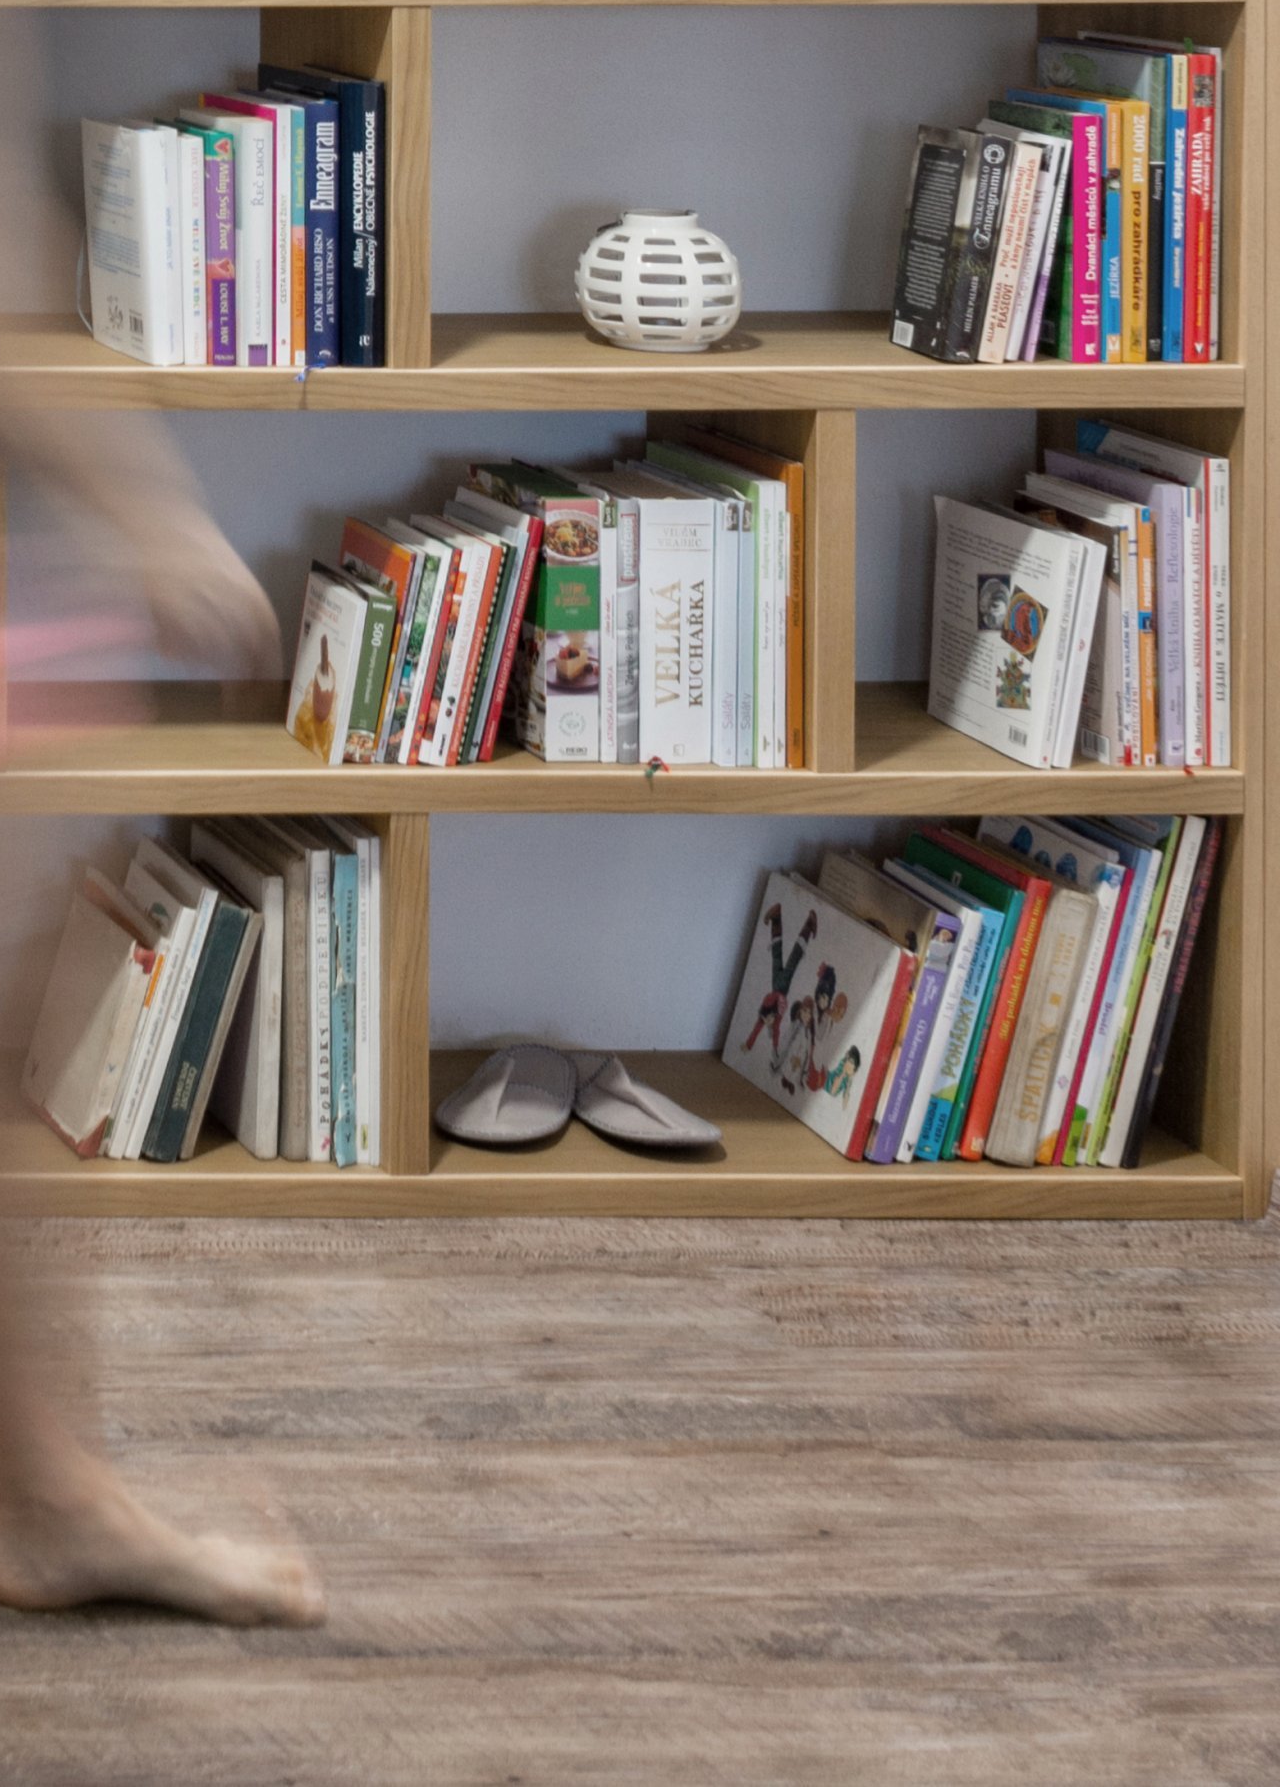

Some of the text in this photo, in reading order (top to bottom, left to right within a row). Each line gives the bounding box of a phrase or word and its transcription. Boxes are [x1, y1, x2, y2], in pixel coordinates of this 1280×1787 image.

[250, 137, 265, 206] ŘEČ EMOCÍ
[310, 121, 337, 211] Enneagram
[1087, 125, 1097, 173] zahradě
[1089, 175, 1097, 183] v
[1191, 132, 1203, 196] ZAHRADA
[353, 151, 364, 268] Milan ENCYKLOPEDIE
[363, 111, 378, 296] Nakonečný OBECNÉ PSYCHOLOGIE
[1085, 186, 1097, 230] měsíců
[1131, 114, 1145, 311] 2000 rad pro zahrádkáře
[1085, 233, 1096, 281] Dvanáct
[1109, 256, 1120, 299] JEZÍRKA
[314, 306, 323, 332] DON
[1166, 506, 1179, 673] Velká kniha Reflexologie
[372, 622, 384, 646] 500
[650, 579, 682, 708] VELKÁ
[688, 579, 705, 708] KUCHAŘKA
[722, 691, 734, 730] Saláty
[741, 692, 753, 730] Saláty
[941, 997, 976, 1078] POHÁDKY
[320, 1028, 331, 1124] POHÁDKY
